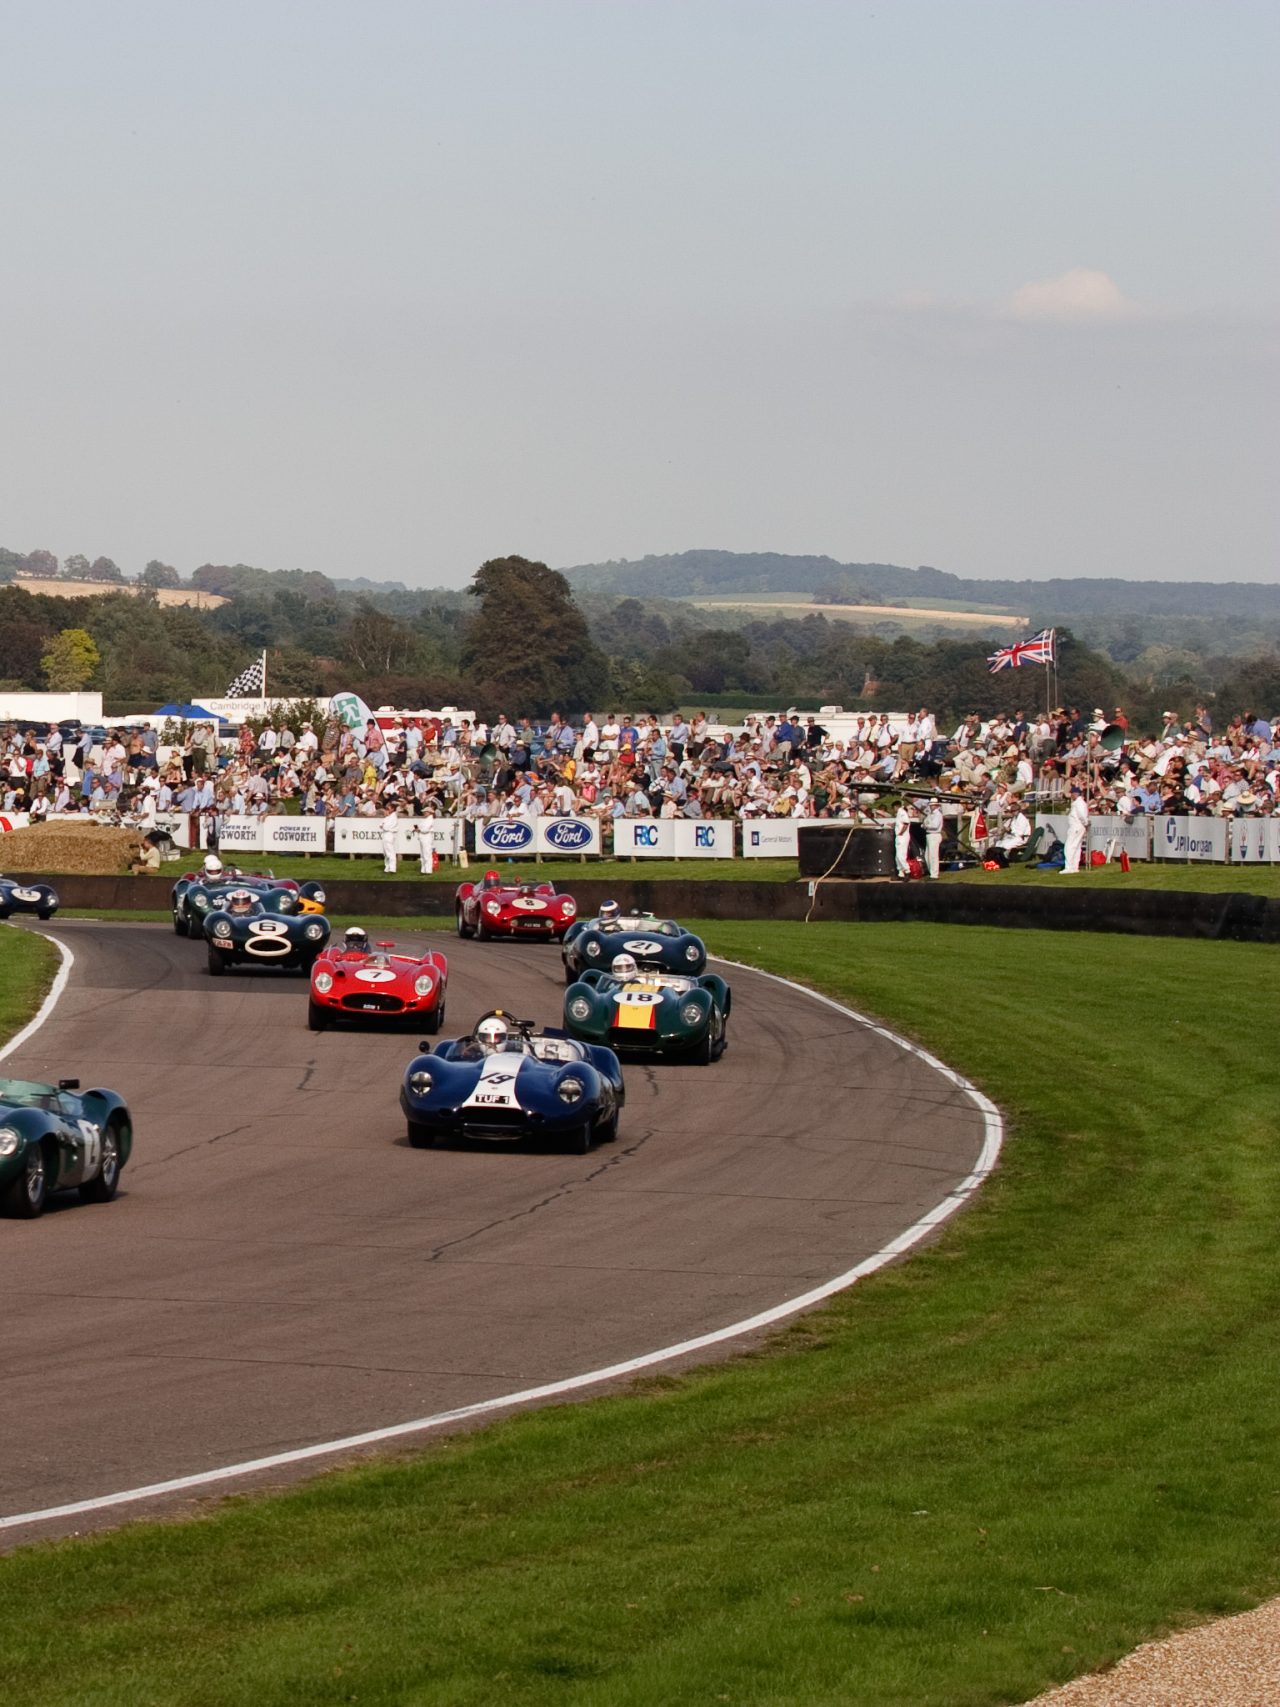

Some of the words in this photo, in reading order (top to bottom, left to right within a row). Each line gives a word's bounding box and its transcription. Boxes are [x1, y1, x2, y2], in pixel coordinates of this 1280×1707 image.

[210, 702, 261, 713] Cambridge
[221, 831, 257, 840] SWORTH
[273, 831, 317, 841] COSWORTH
[352, 831, 382, 840] ROLEX
[490, 824, 525, 844] Ford
[554, 823, 583, 844] Ford
[259, 922, 277, 931] 6
[631, 941, 653, 950] 21
[626, 993, 653, 1002] 18
[477, 1095, 500, 1103] TUF
[503, 1096, 509, 1104] 1
